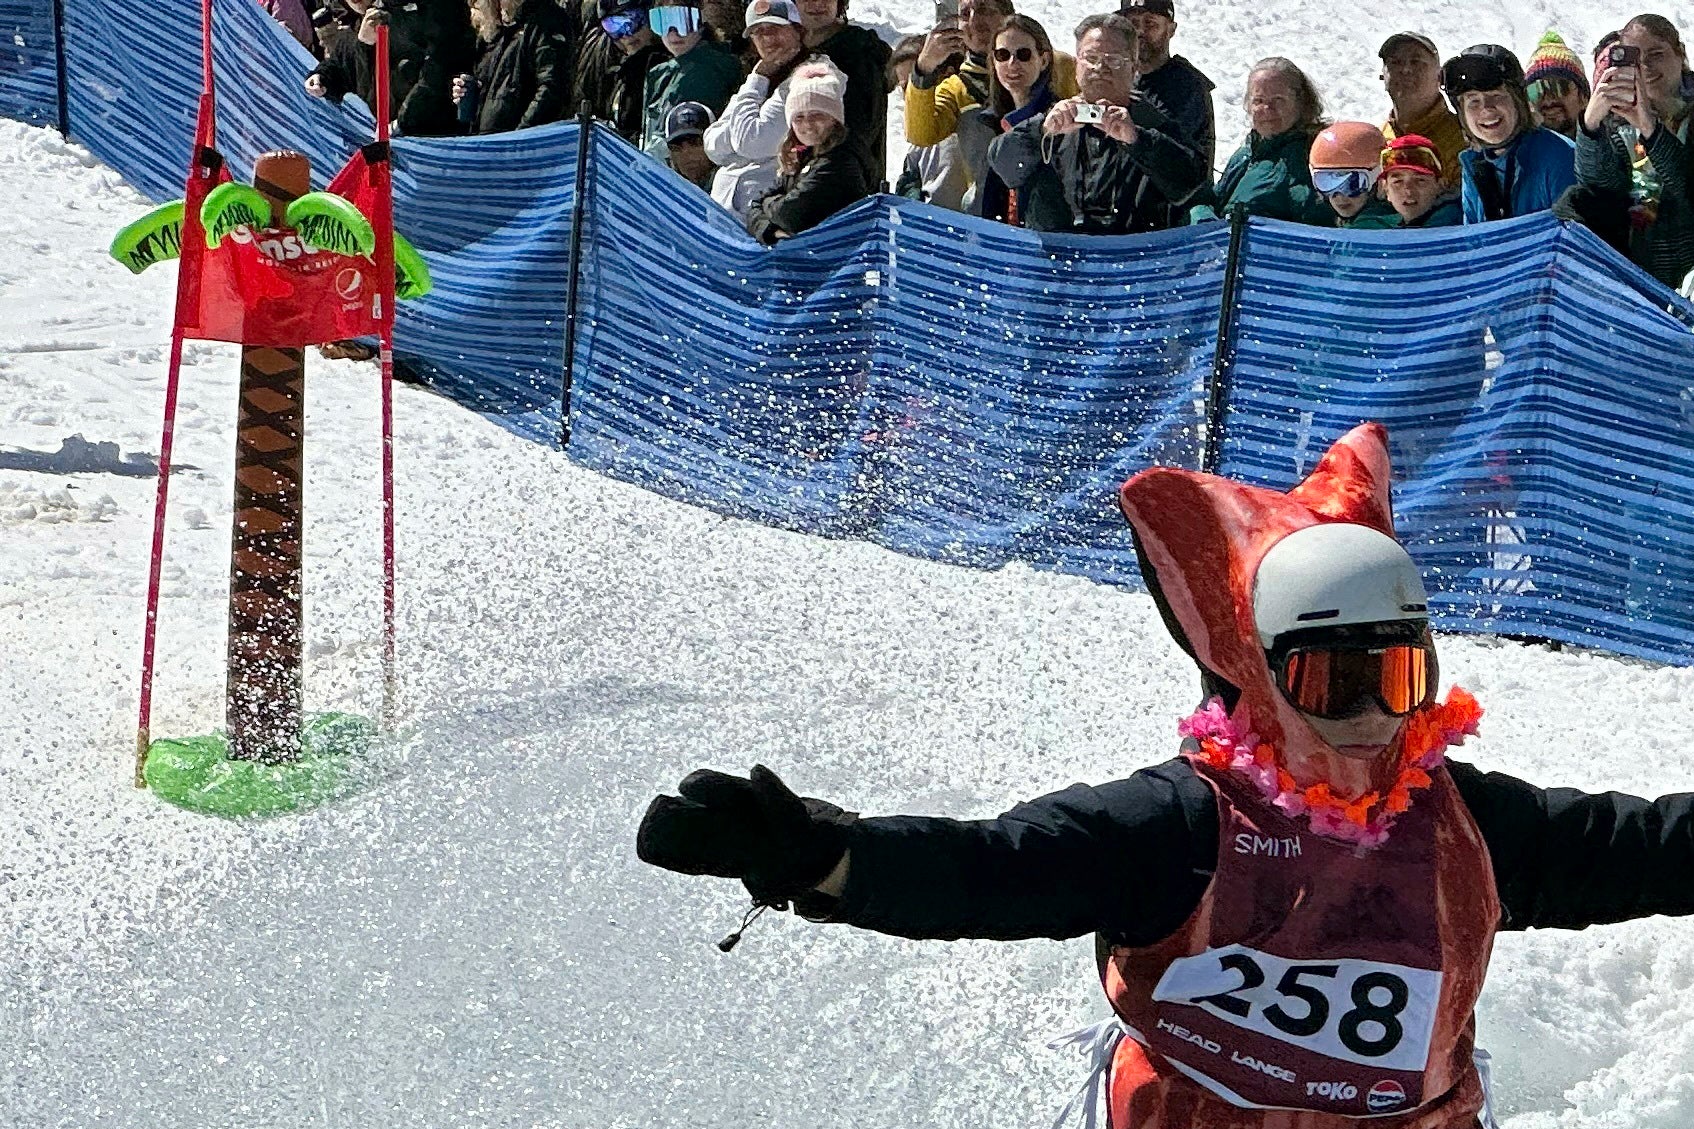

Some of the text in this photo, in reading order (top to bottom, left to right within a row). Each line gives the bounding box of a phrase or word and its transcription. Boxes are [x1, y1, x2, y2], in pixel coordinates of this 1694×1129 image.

[1234, 833, 1302, 858] SMITH
[1189, 953, 1409, 1057] 258
[1157, 1019, 1221, 1053] HEAD
[1231, 1051, 1296, 1083] LANGE
[1306, 1082, 1358, 1100] TOKO
